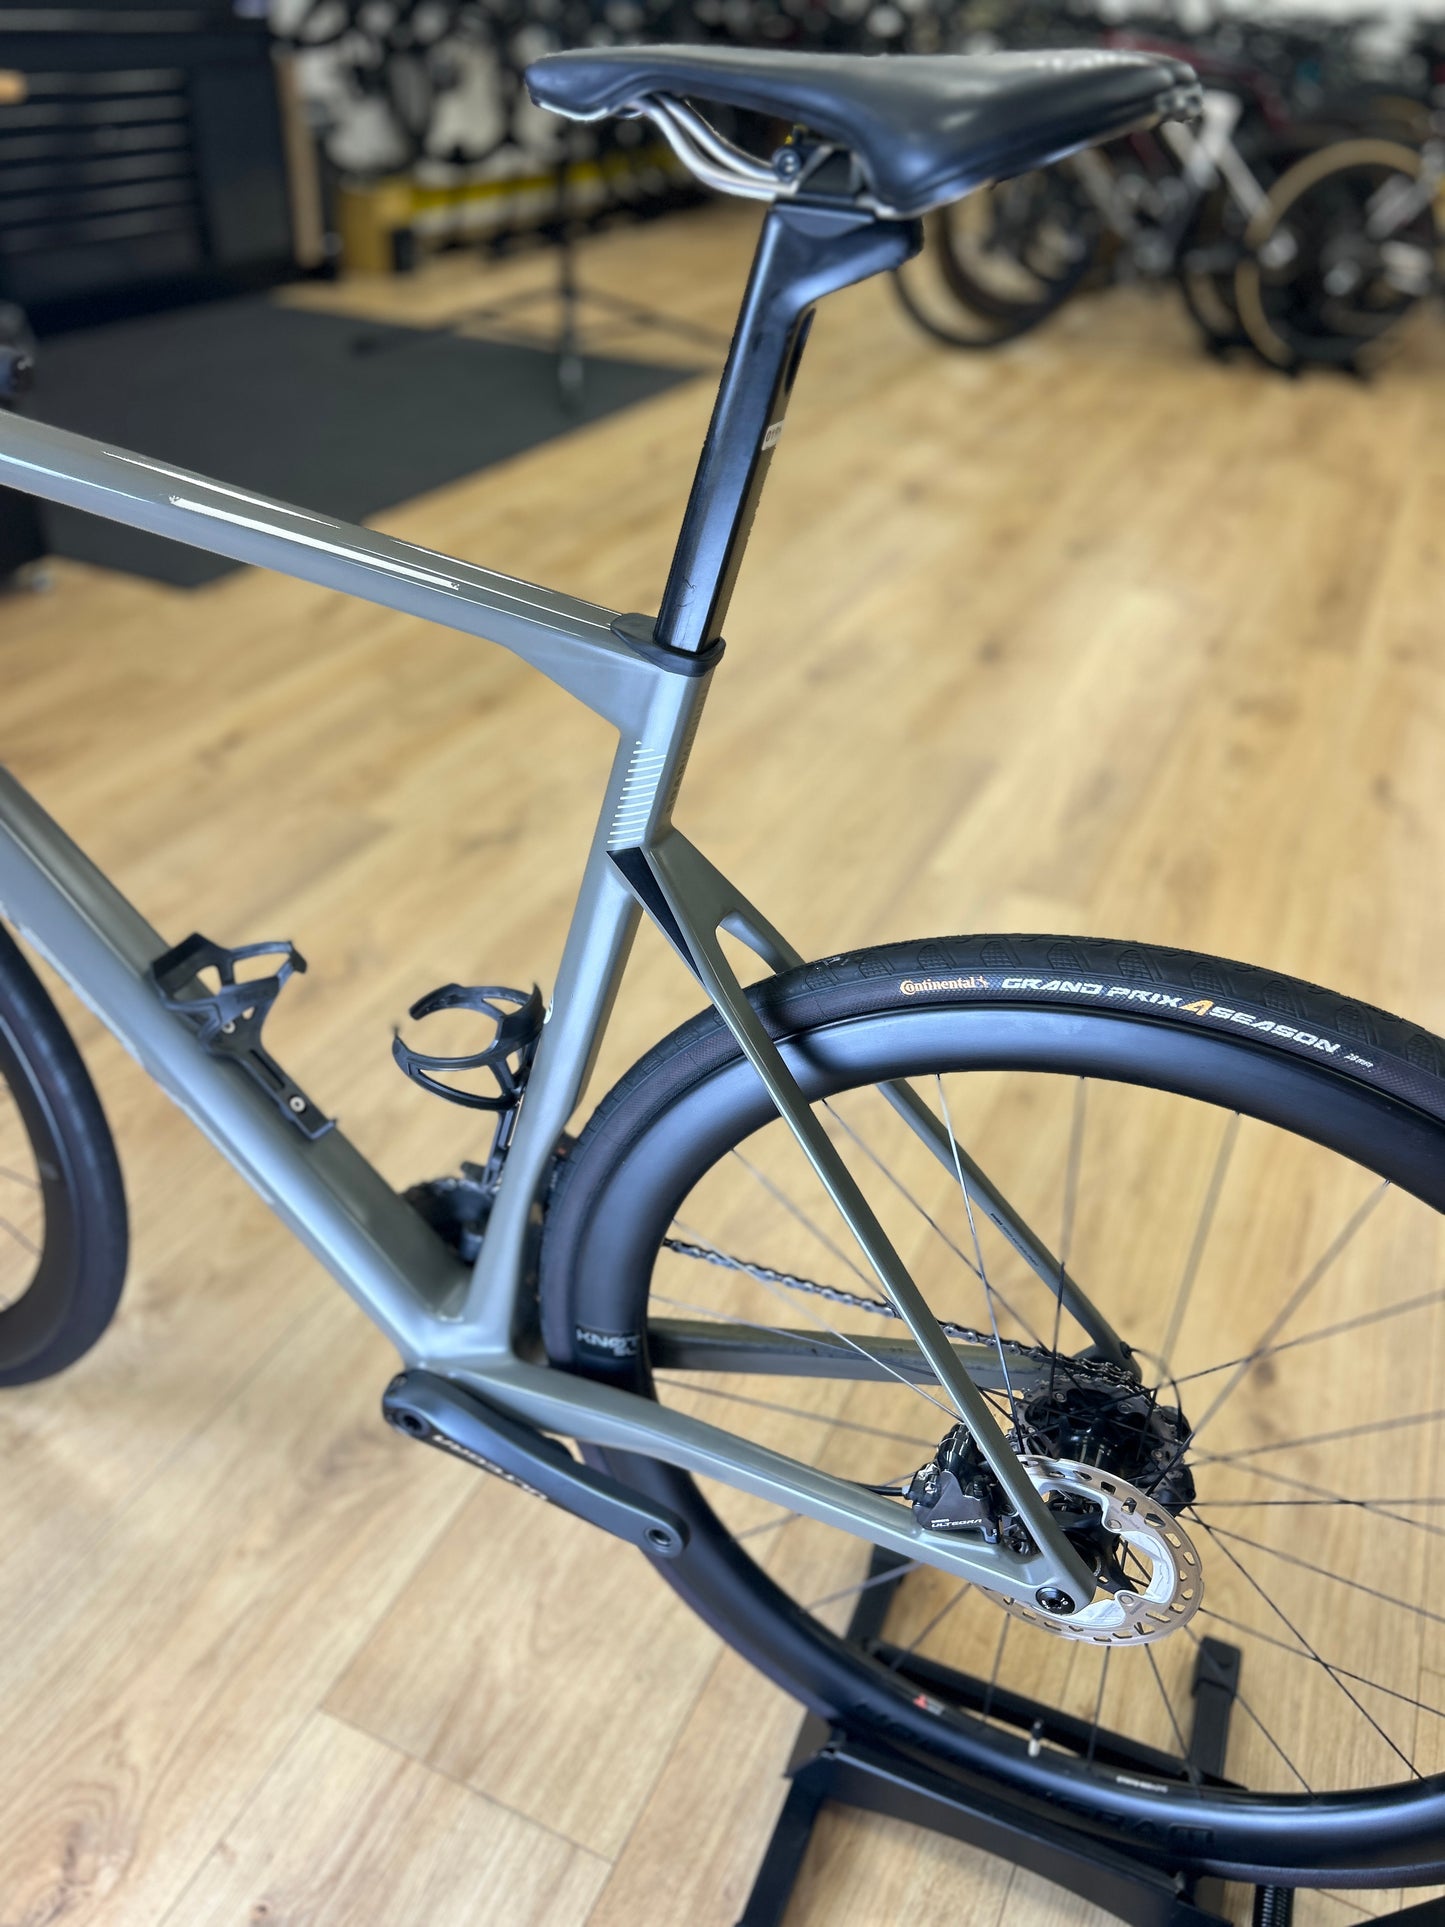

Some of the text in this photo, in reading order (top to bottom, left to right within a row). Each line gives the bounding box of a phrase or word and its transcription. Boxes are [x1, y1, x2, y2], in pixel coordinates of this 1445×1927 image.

[900, 976, 977, 996] Continental
[1001, 978, 1100, 995] GRAND
[1106, 986, 1183, 1008] PRIX
